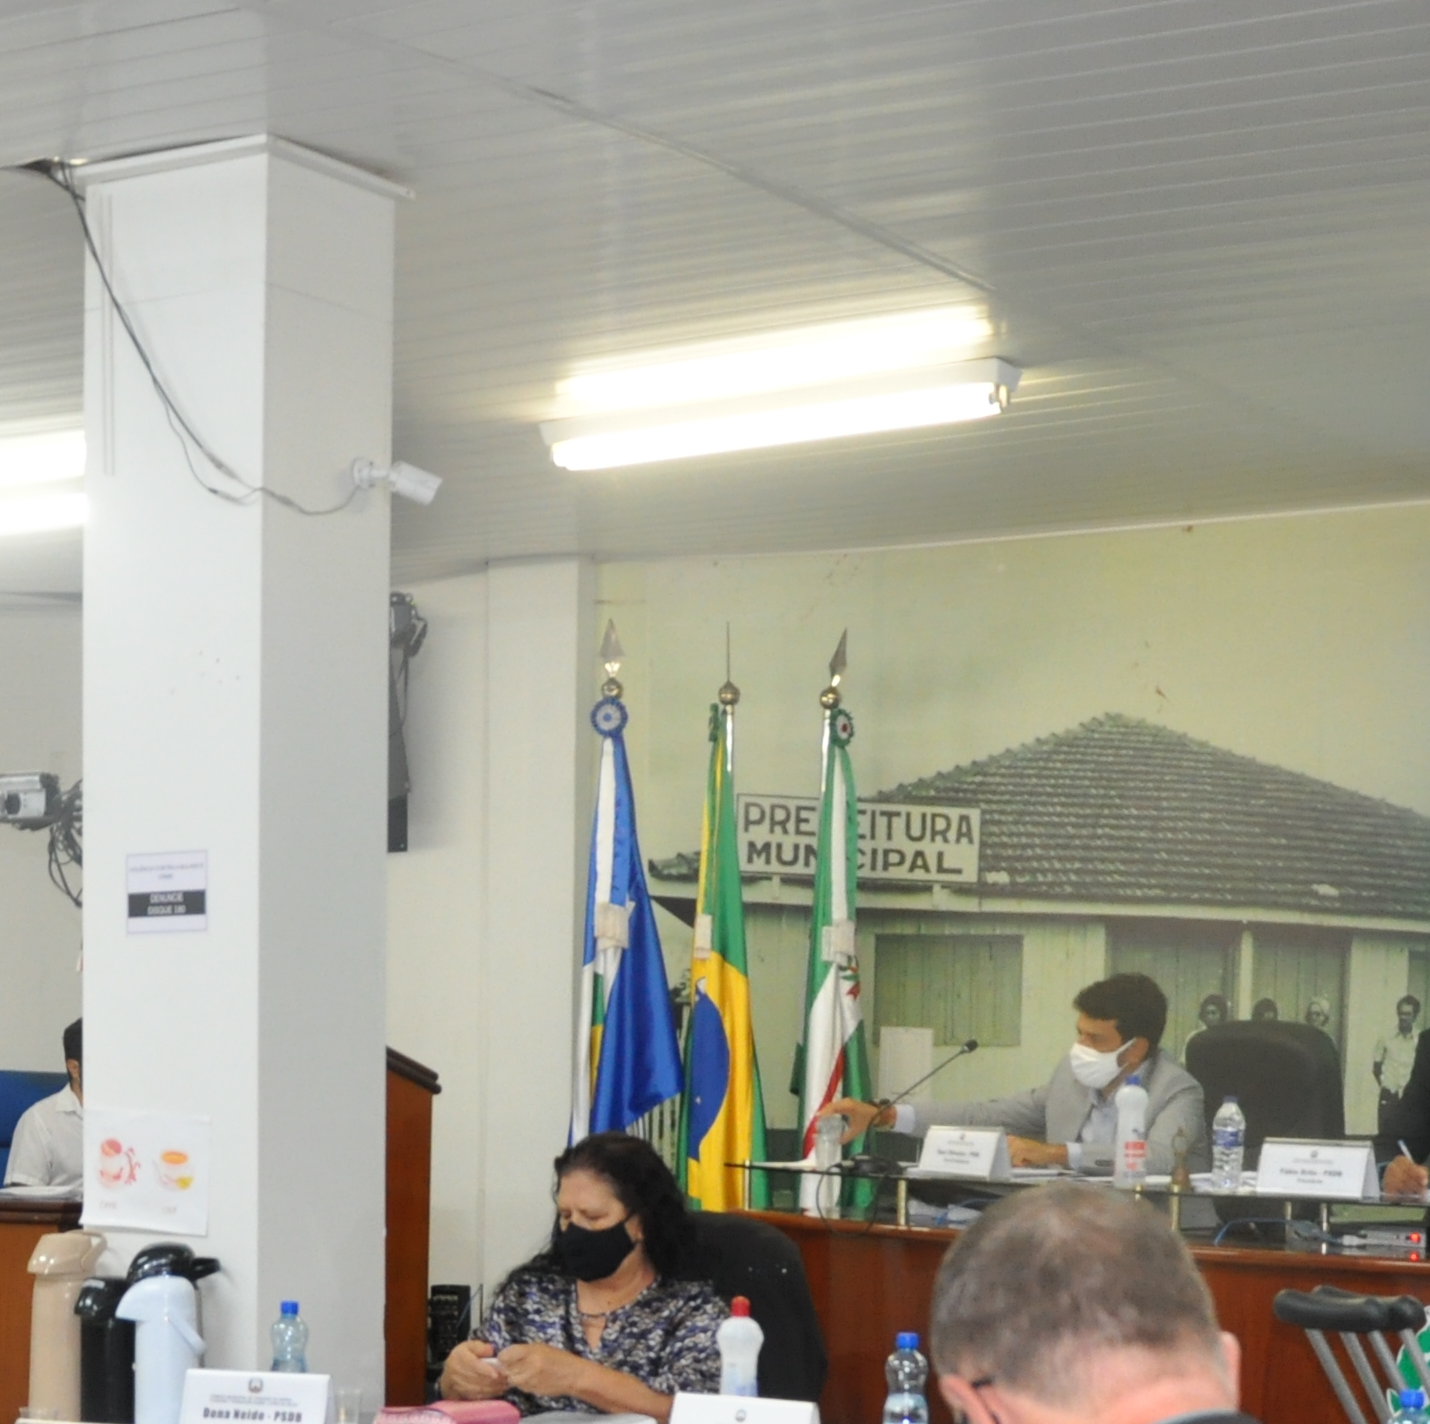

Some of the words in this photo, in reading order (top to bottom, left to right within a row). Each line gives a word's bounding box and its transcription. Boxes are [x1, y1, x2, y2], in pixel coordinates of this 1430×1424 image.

[203, 1407, 230, 1419] Dona
[233, 1408, 265, 1421] Neide
[273, 1411, 302, 1423] PSDB
